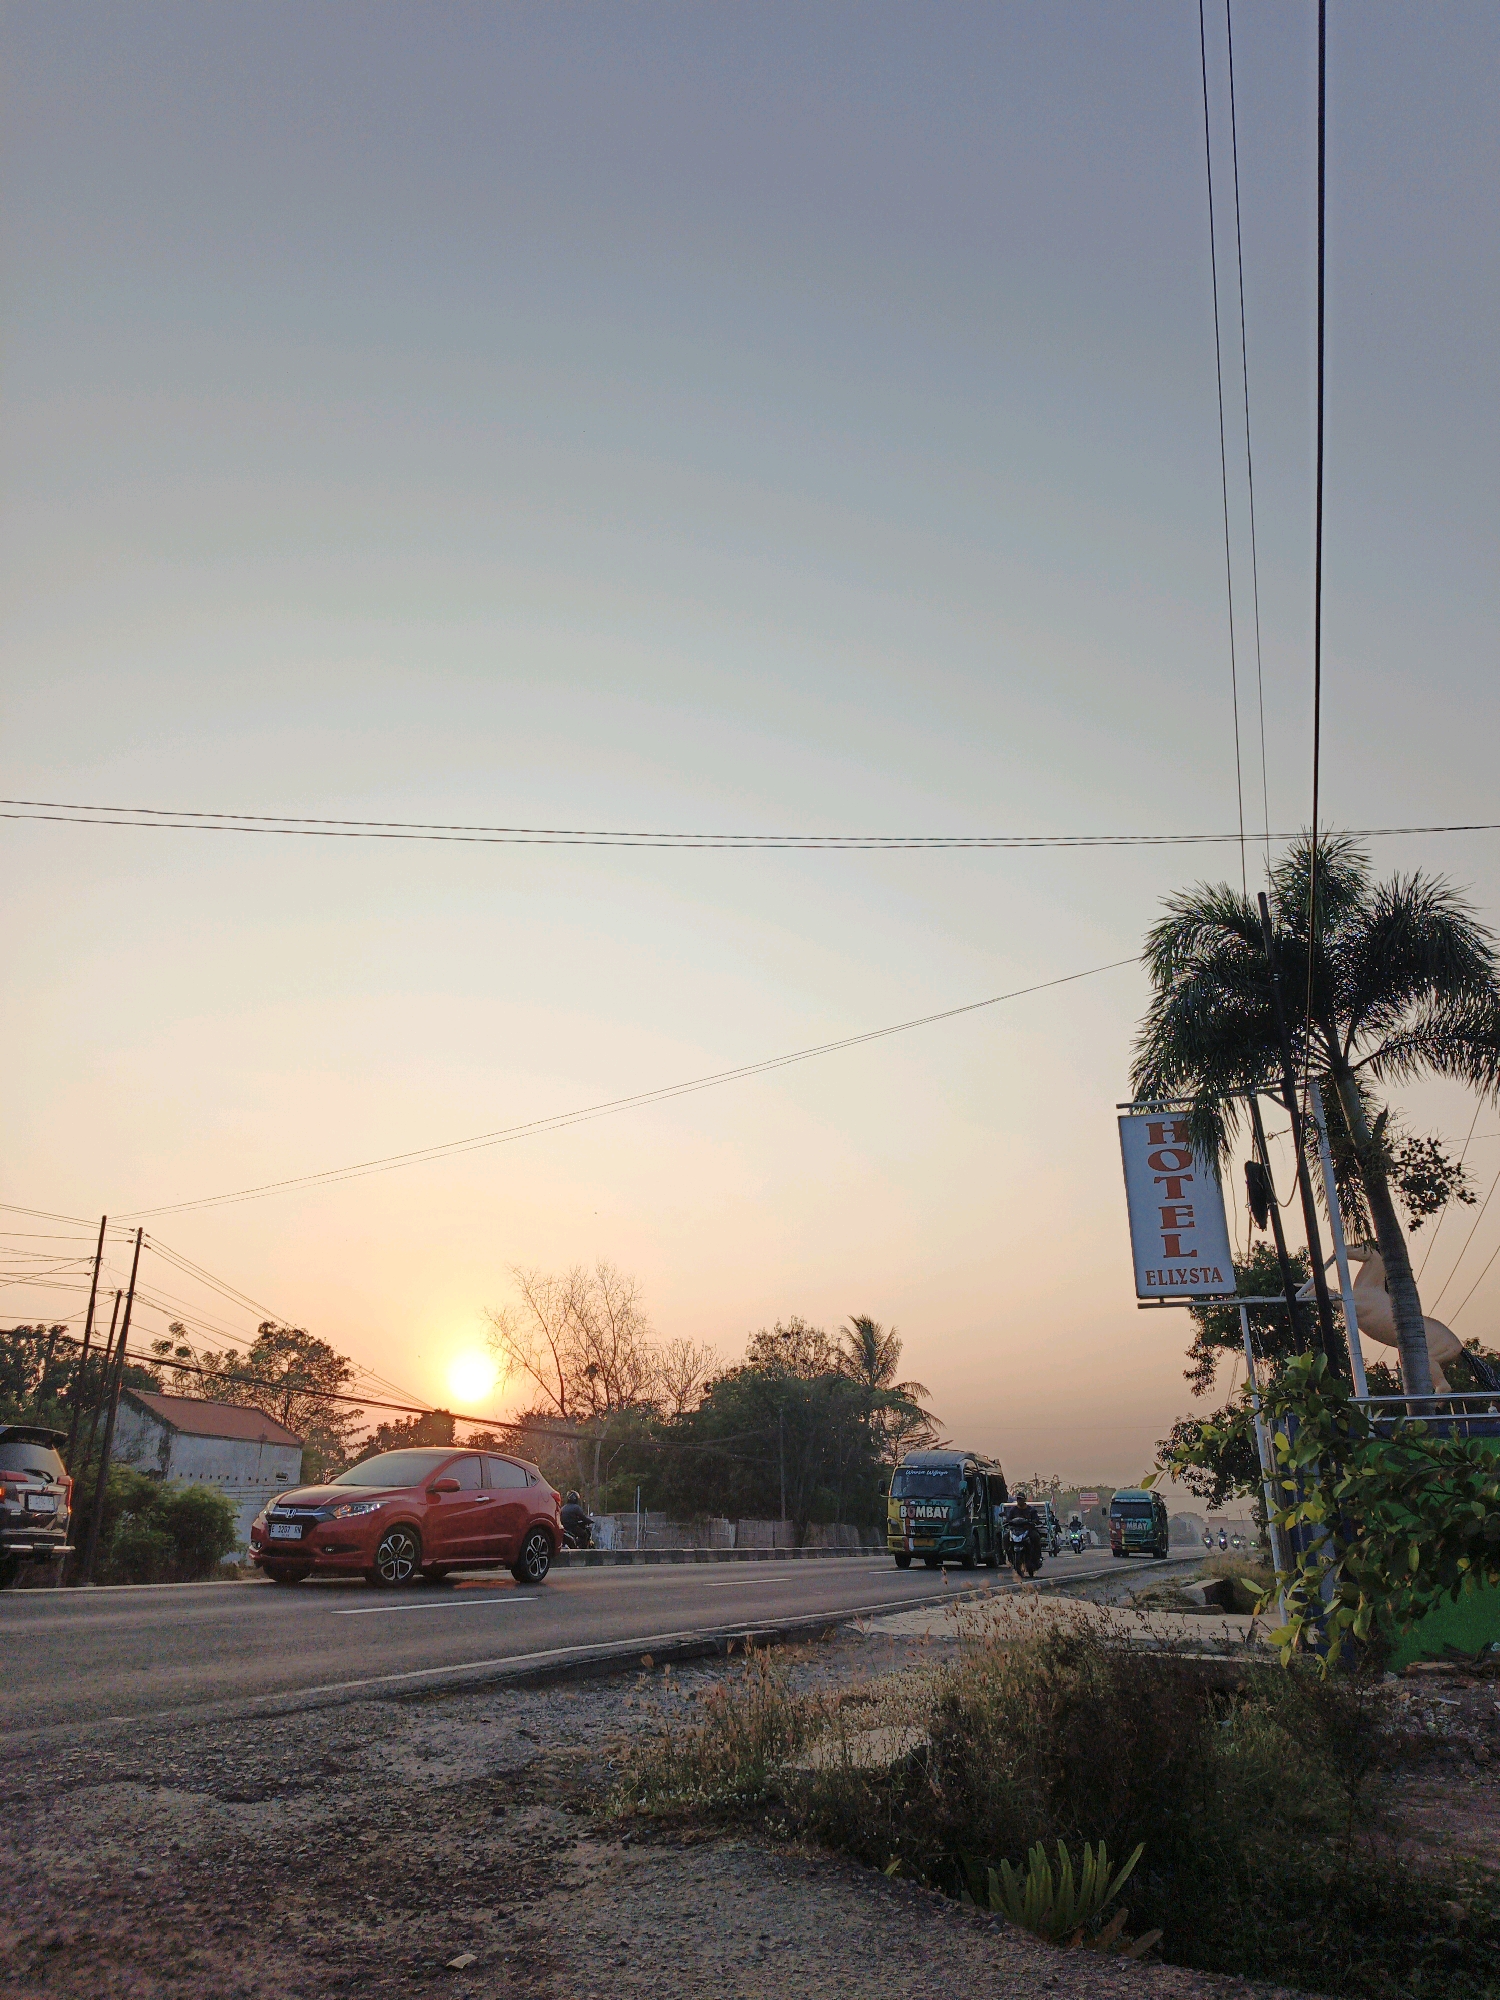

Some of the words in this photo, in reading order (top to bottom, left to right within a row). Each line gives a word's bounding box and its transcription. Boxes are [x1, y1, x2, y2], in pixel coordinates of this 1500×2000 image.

[1145, 1121, 1198, 1259] HOTEL
[1145, 1267, 1224, 1287] ELLYSTA
[900, 1505, 950, 1519] BOMBAY
